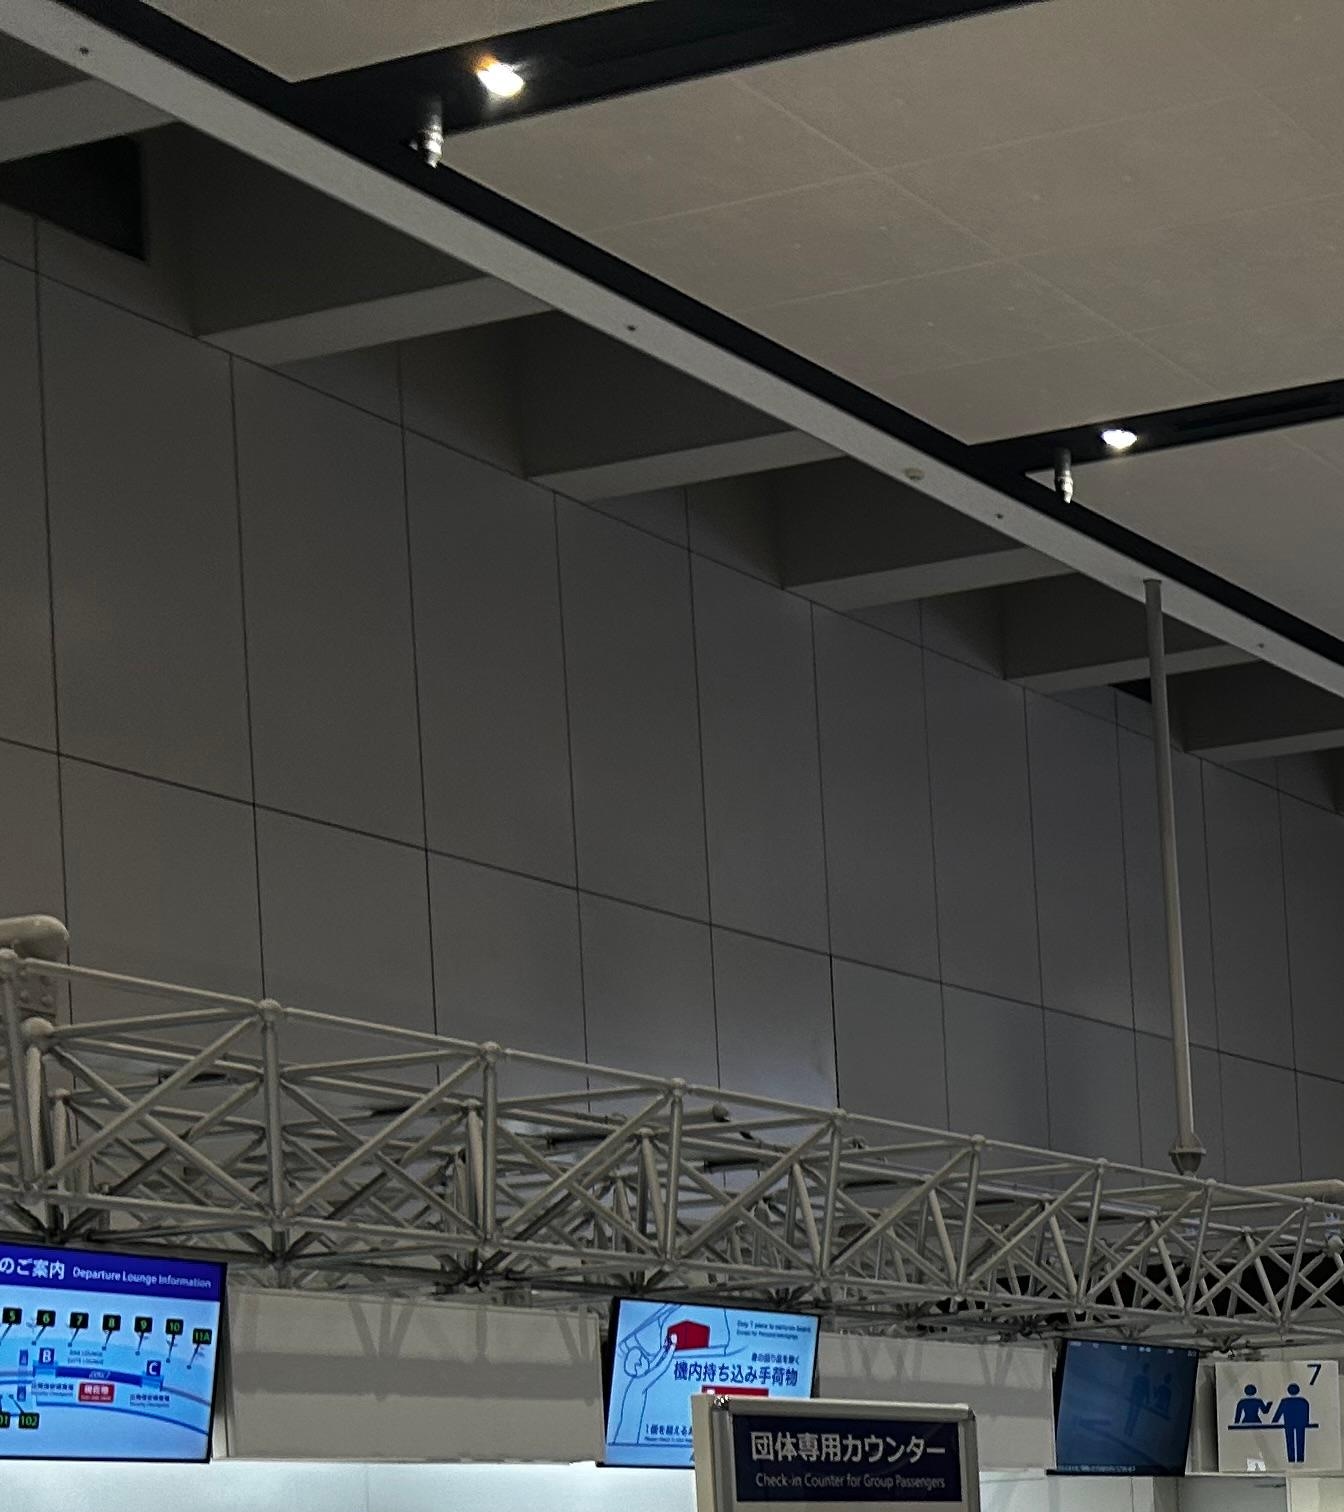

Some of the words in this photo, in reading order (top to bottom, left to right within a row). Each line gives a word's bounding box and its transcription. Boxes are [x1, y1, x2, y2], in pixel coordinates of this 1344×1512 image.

[73, 1266, 120, 1281] Departure
[122, 1270, 157, 1285] Lounge
[159, 1276, 212, 1289] Information
[674, 1361, 798, 1386] 機内持ち込み手荷物
[1307, 1364, 1322, 1386] 7
[20, 1416, 37, 1426] 102
[750, 1431, 945, 1463] 団体専用カウンター
[756, 1472, 802, 1487] Check-in
[805, 1473, 844, 1488] Counter
[847, 1474, 860, 1487] for
[864, 1475, 893, 1489] Group
[896, 1476, 945, 1490] Passengers
